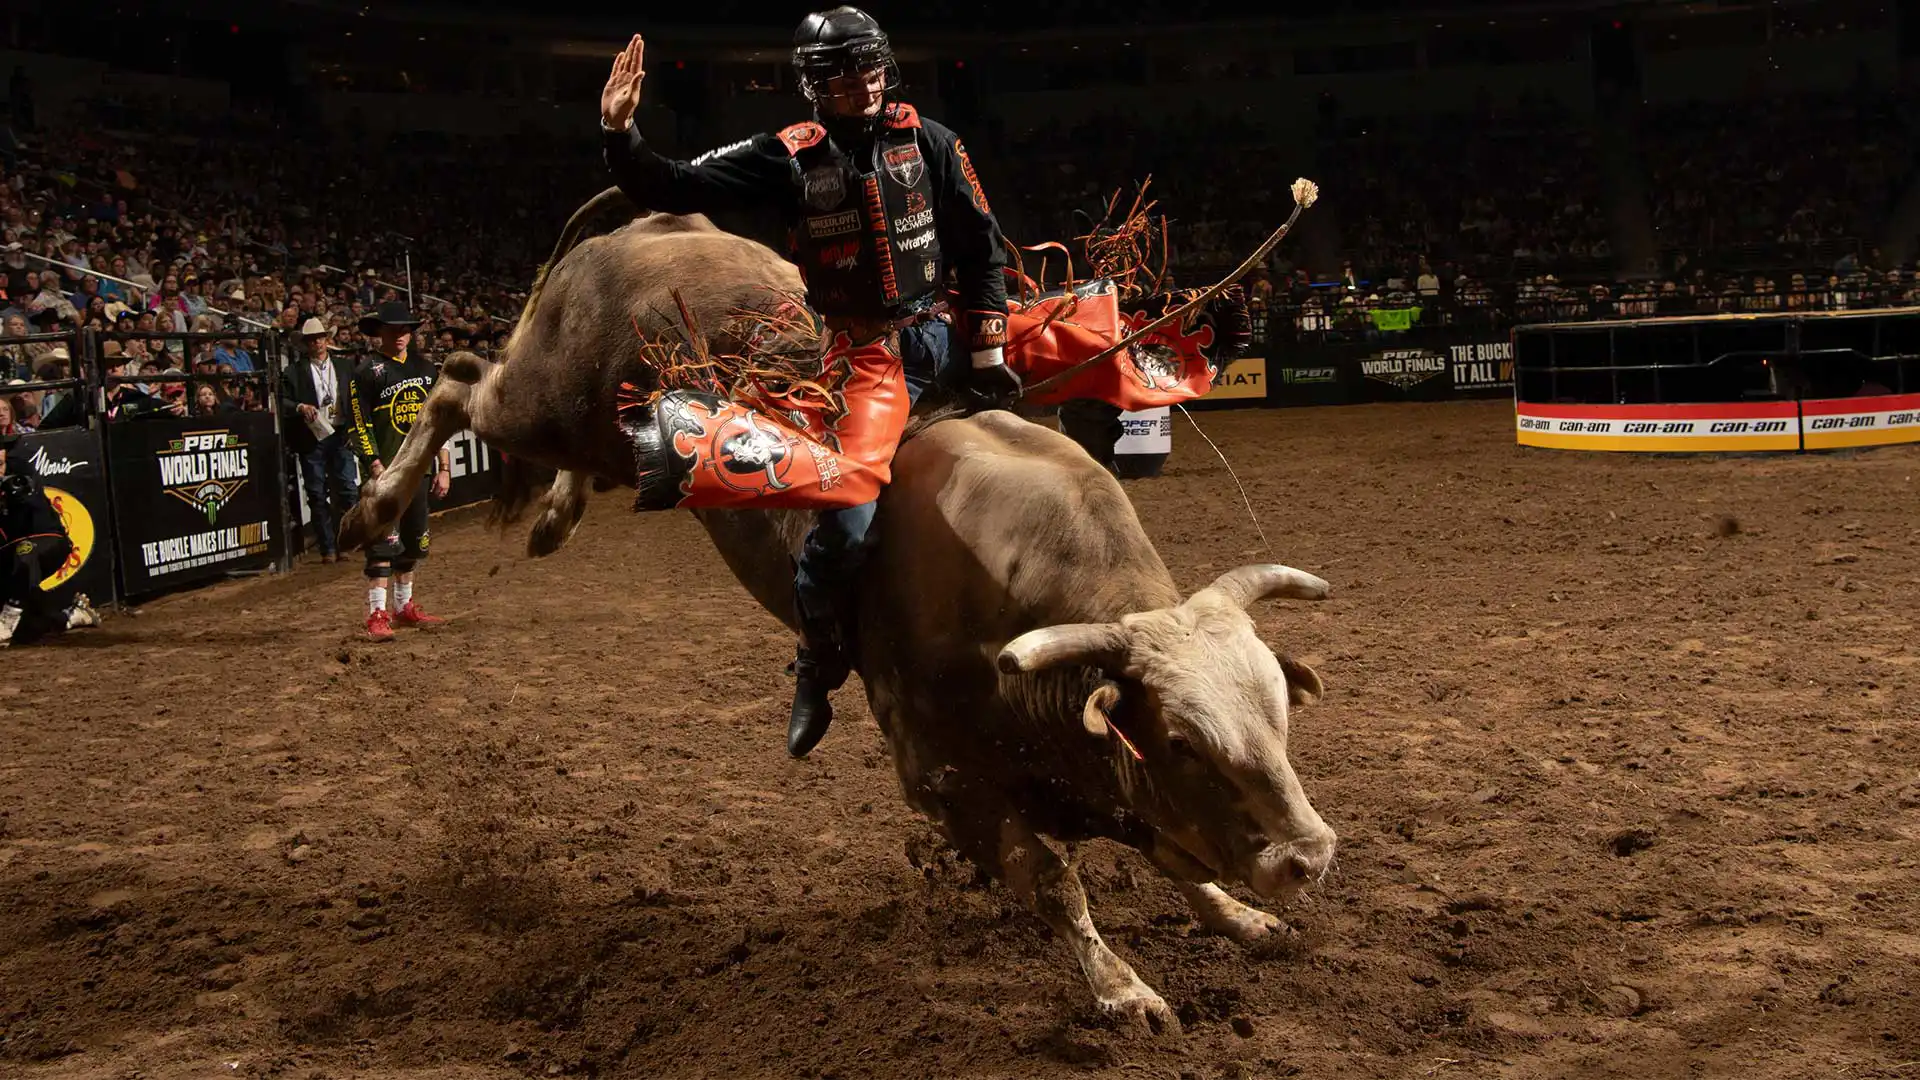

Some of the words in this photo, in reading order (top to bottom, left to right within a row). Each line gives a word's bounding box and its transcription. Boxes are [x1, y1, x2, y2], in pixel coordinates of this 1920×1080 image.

[894, 214, 916, 227] BAD
[916, 208, 933, 221] BOY
[896, 216, 934, 235] MOWERS
[896, 229, 935, 252] Wrangler
[1450, 345, 1474, 362] THE
[1361, 360, 1401, 374] WORLD
[1405, 357, 1446, 373] FINALS
[1453, 364, 1467, 383] IT
[1470, 363, 1496, 382] ALL
[1520, 417, 1551, 430] can-am
[1559, 421, 1611, 433] can-am
[1623, 422, 1694, 433] can-am
[1709, 421, 1787, 433] can-am
[1811, 415, 1876, 430] can-am
[28, 445, 89, 476] Morris
[445, 430, 490, 479] ETI
[159, 453, 208, 486] WORLD
[209, 449, 248, 480] FINALS
[827, 457, 842, 485] BOY
[142, 542, 159, 566] THE
[159, 536, 190, 563] BUCKLE
[190, 531, 217, 557] MAKES
[218, 529, 226, 551] IT
[226, 527, 239, 549] ALL
